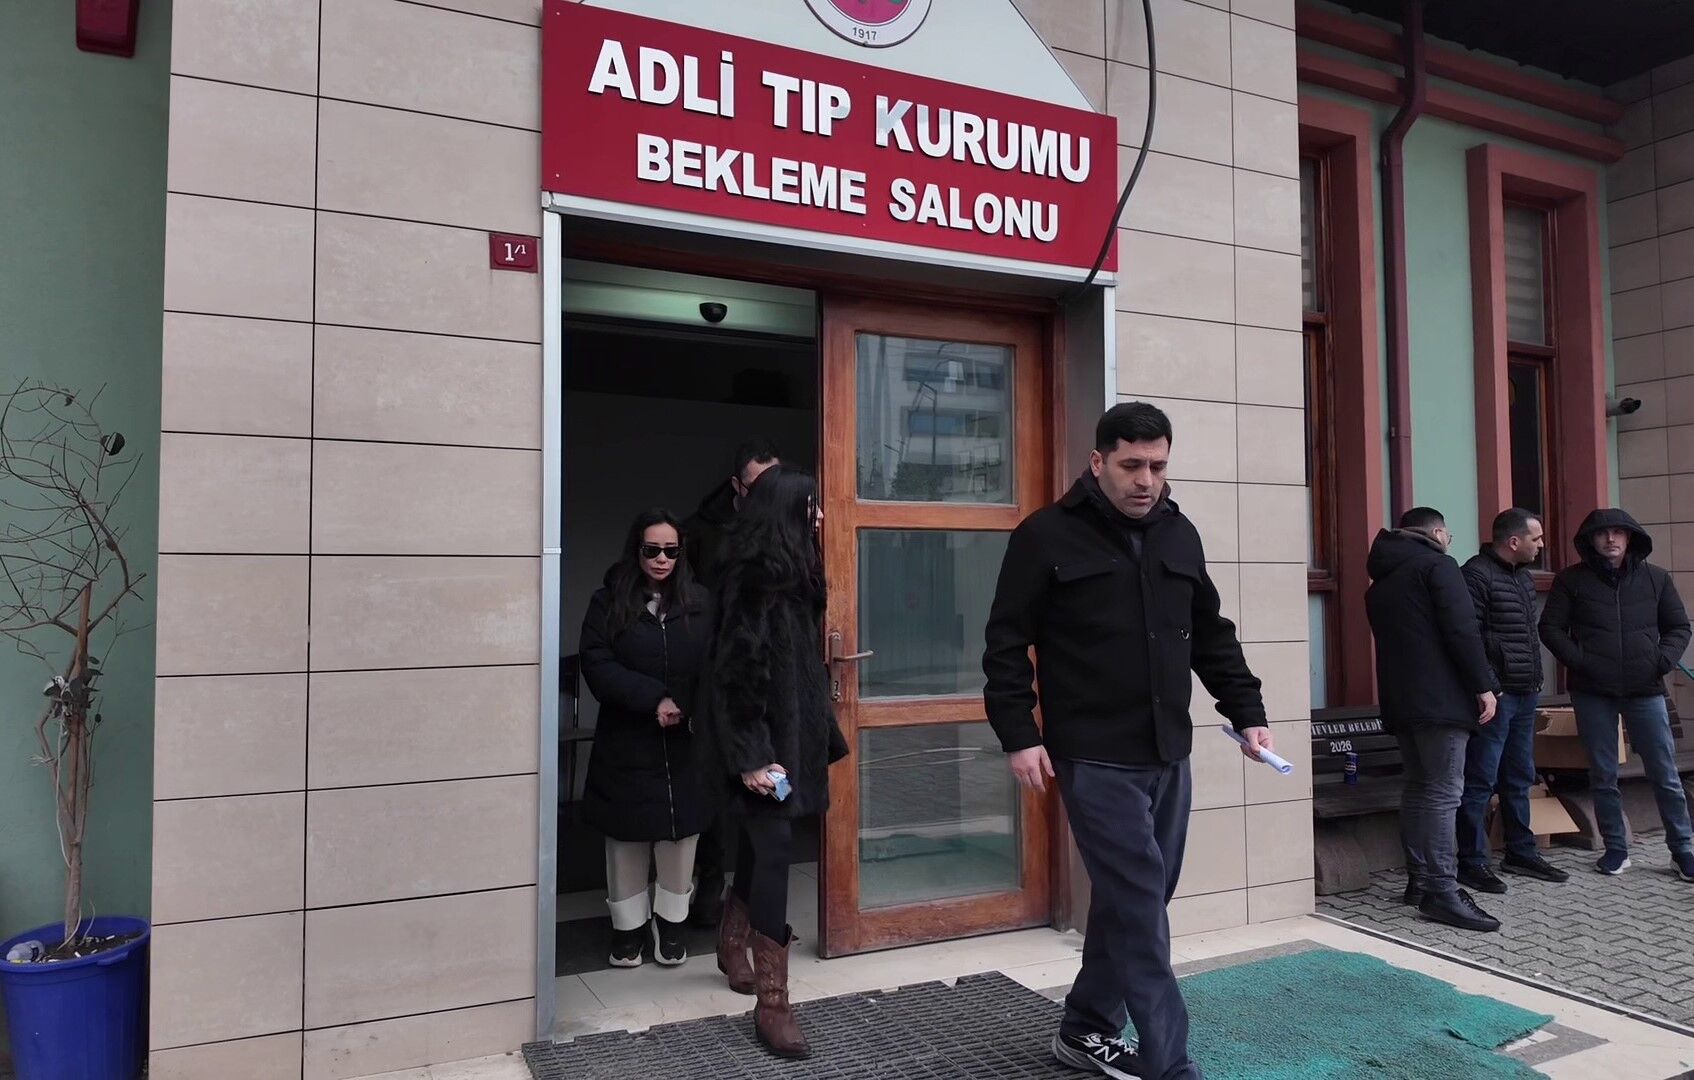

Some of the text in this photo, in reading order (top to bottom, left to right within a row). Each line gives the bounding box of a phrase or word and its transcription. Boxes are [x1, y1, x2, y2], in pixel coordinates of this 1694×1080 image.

[852, 27, 877, 41] 1917
[588, 39, 1091, 183] ADLİ TIP KURUMU
[637, 133, 1059, 242] BEKLEME SALONU
[1330, 740, 1352, 753] 2026
